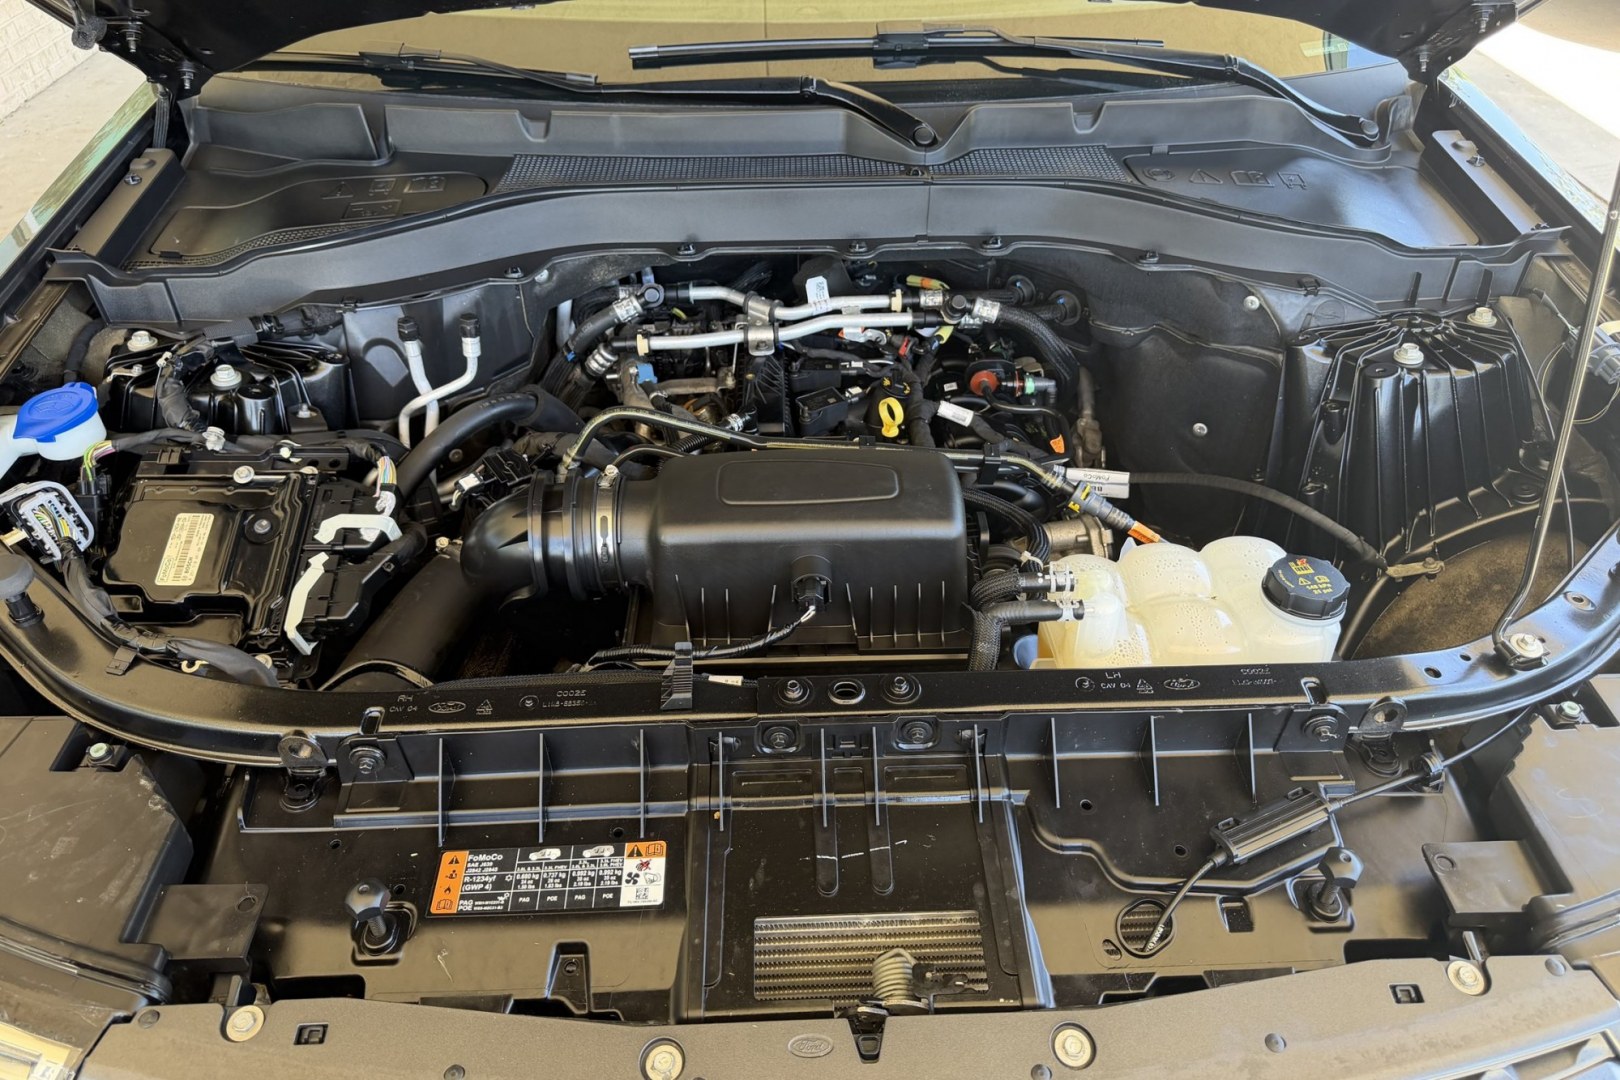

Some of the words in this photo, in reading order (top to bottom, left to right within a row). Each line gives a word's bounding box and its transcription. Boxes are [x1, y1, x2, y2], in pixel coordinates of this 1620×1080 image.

[1083, 473, 1110, 481] FoMoCo
[184, 557, 193, 574] BOSCH
[468, 853, 504, 861] FoMoCo
[464, 875, 496, 883] R-1234yf
[462, 884, 483, 892] (GWP
[484, 883, 493, 892] 4)
